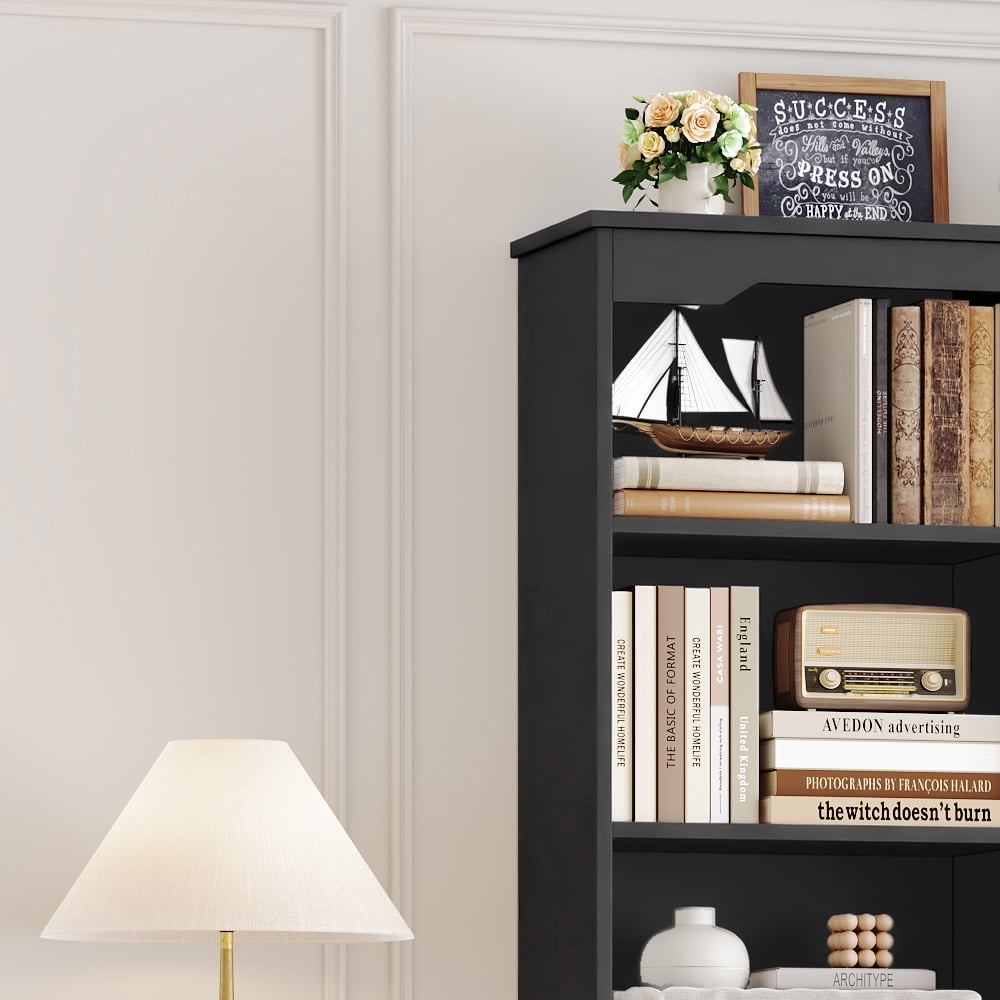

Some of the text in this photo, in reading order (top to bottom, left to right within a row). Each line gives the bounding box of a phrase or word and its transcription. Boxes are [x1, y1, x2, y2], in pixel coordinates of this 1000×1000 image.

[778, 121, 903, 140] does not come without
[801, 135, 829, 153] Hills
[832, 141, 846, 151] and
[823, 155, 836, 164] but
[840, 154, 848, 164] if
[797, 159, 896, 189] PRESS ON
[822, 192, 870, 202] you will be
[805, 204, 844, 219] HAPPY
[865, 206, 888, 220] END
[716, 625, 724, 683] CASA WABI
[736, 616, 751, 672] England
[617, 639, 626, 767] CREATE WONDERFUL HOMELIFE
[666, 636, 676, 768] THE BASIC OF FORMAT
[692, 637, 701, 768] CREATE WONDERFUL HOMELIFE
[822, 717, 960, 738] AVEDON advertising
[737, 716, 749, 802] United Kingdom
[805, 776, 992, 795] PHOTOGRAPHS BY FRANÇOIS HALARD
[818, 801, 844, 821] the
[846, 801, 890, 821] witch
[954, 802, 992, 822] burn
[833, 972, 894, 988] ARCHITYPE
